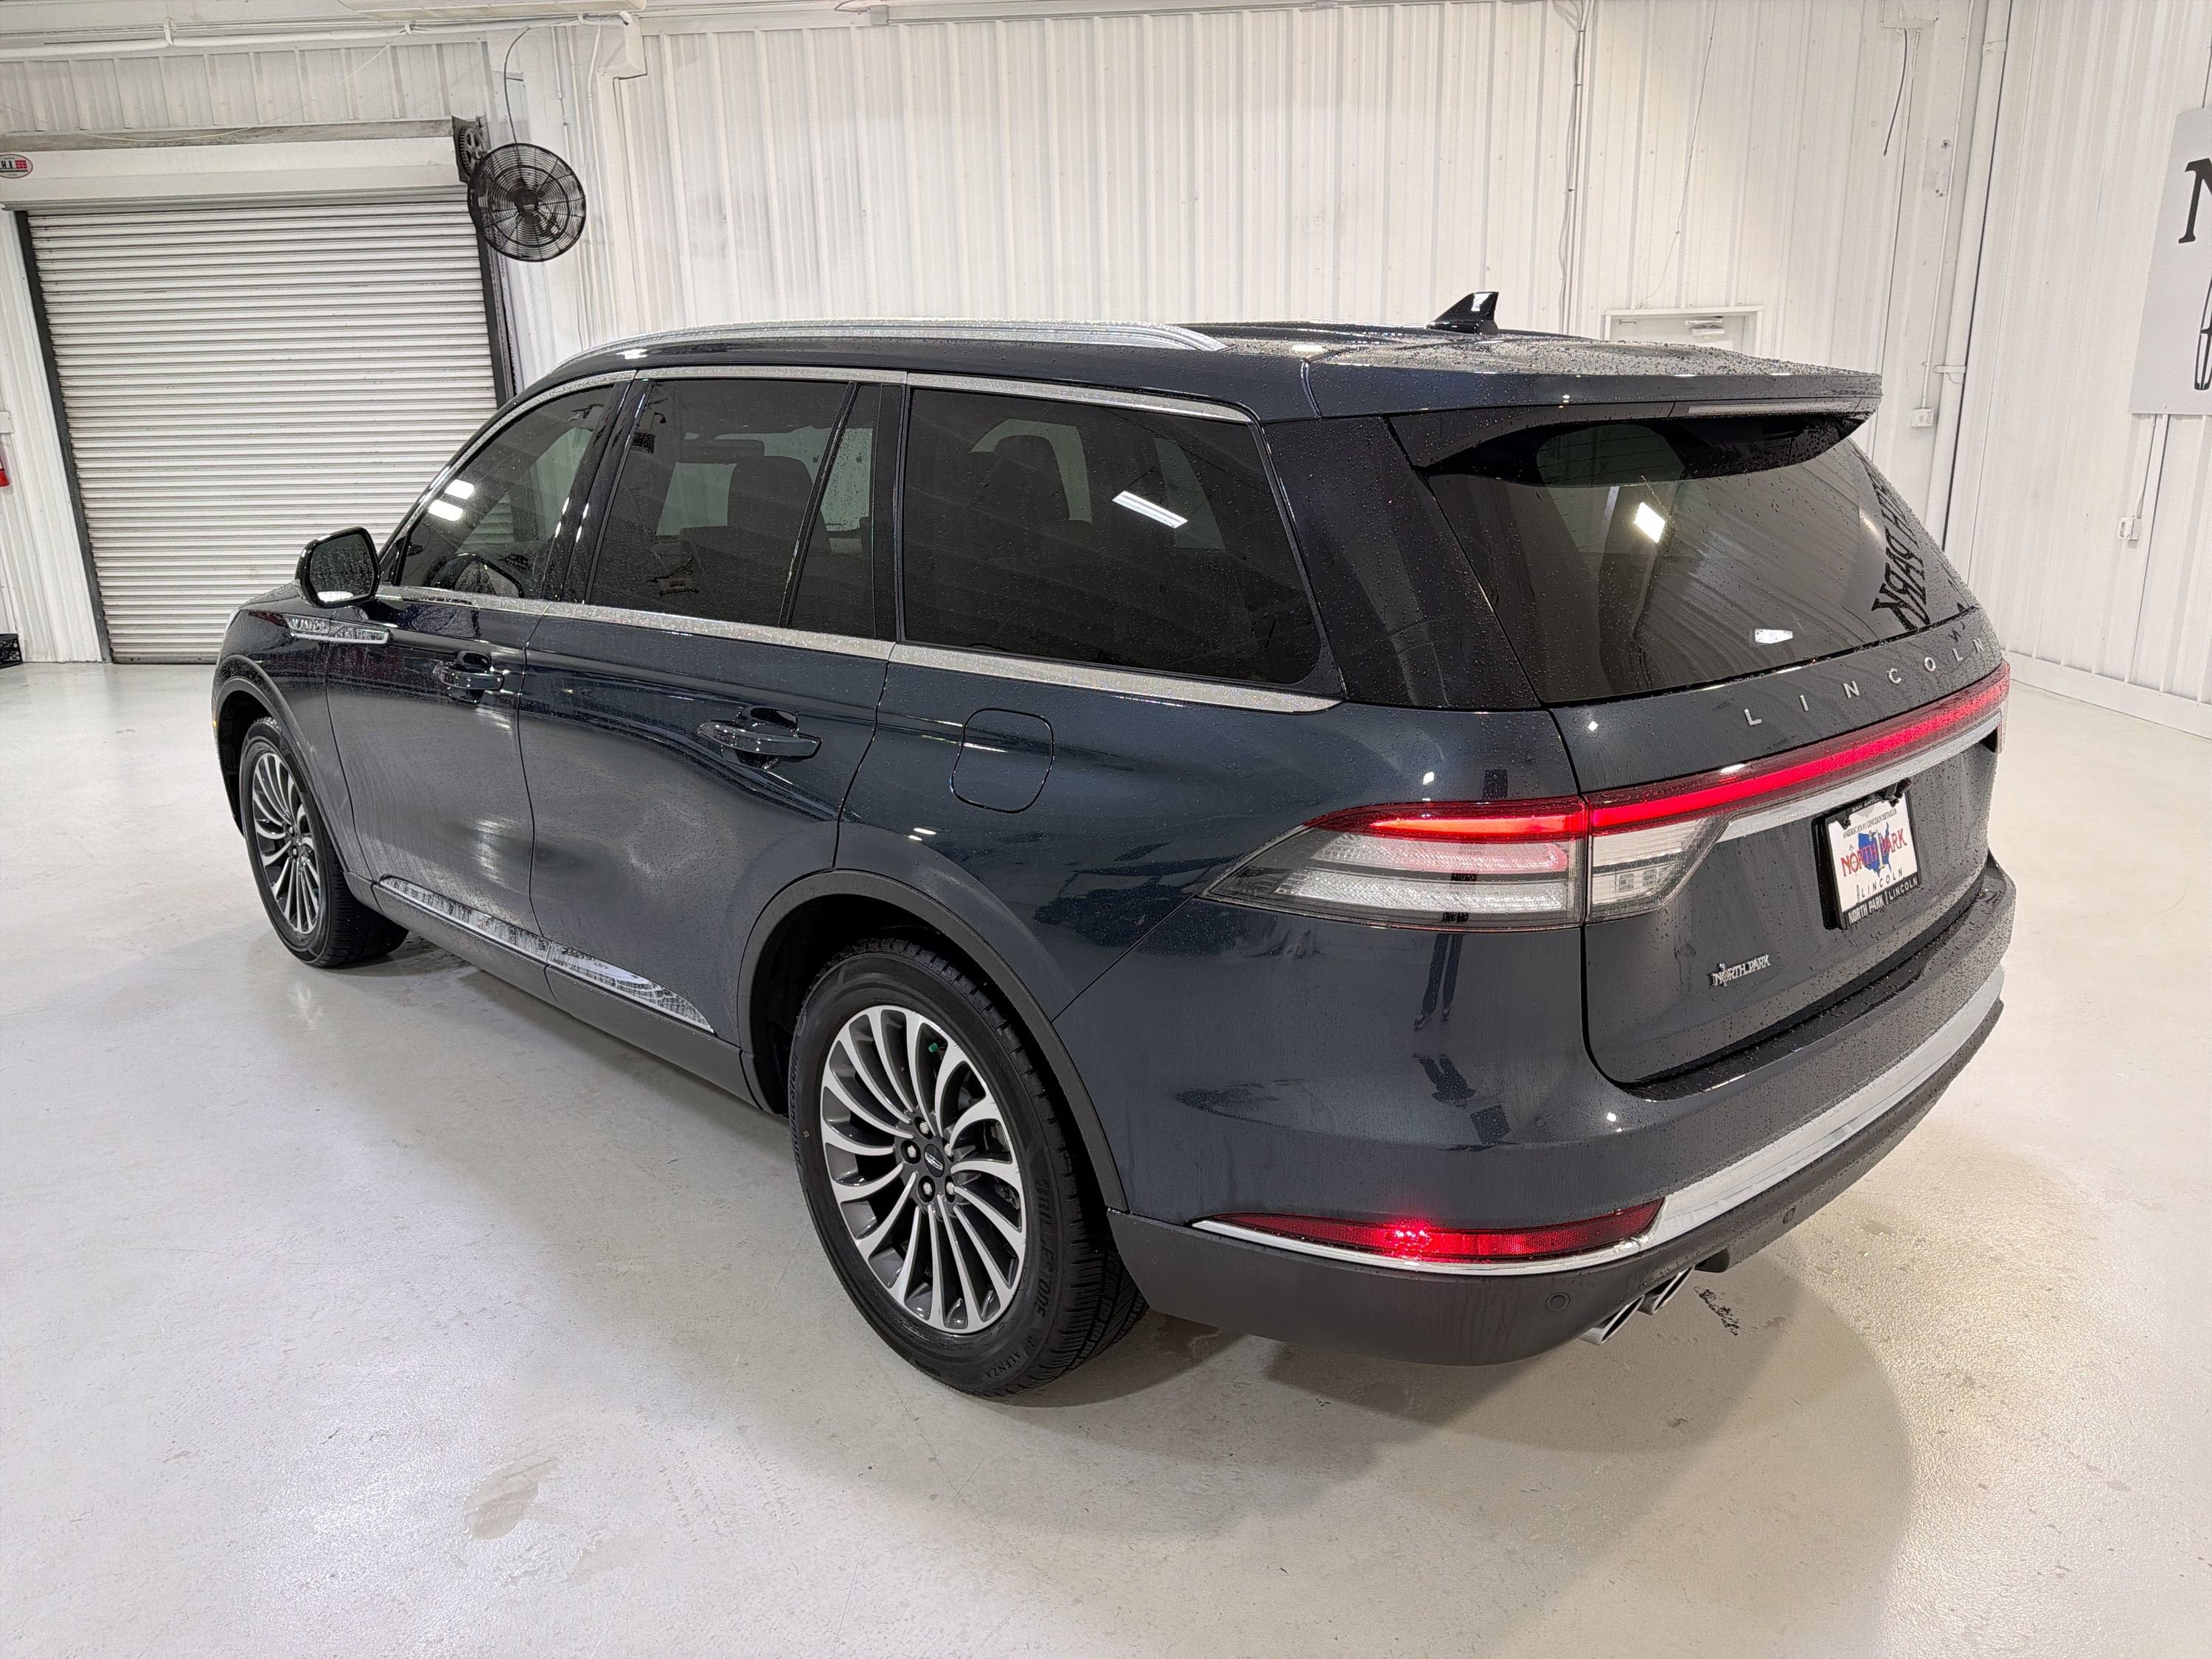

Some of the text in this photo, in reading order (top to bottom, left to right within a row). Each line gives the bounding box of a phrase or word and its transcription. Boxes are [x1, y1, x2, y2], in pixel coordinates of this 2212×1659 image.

[1743, 637, 1985, 727] LINCOLN
[1866, 815, 1882, 828] LINCOLN
[1840, 828, 1907, 877] NORTH PARK
[1861, 867, 1903, 898] LINCOLN
[1848, 877, 1918, 925] NORTH PARK LINCOLN
[1711, 954, 1771, 987] NORTH PARK
[982, 1350, 1022, 1379] ALENZA
